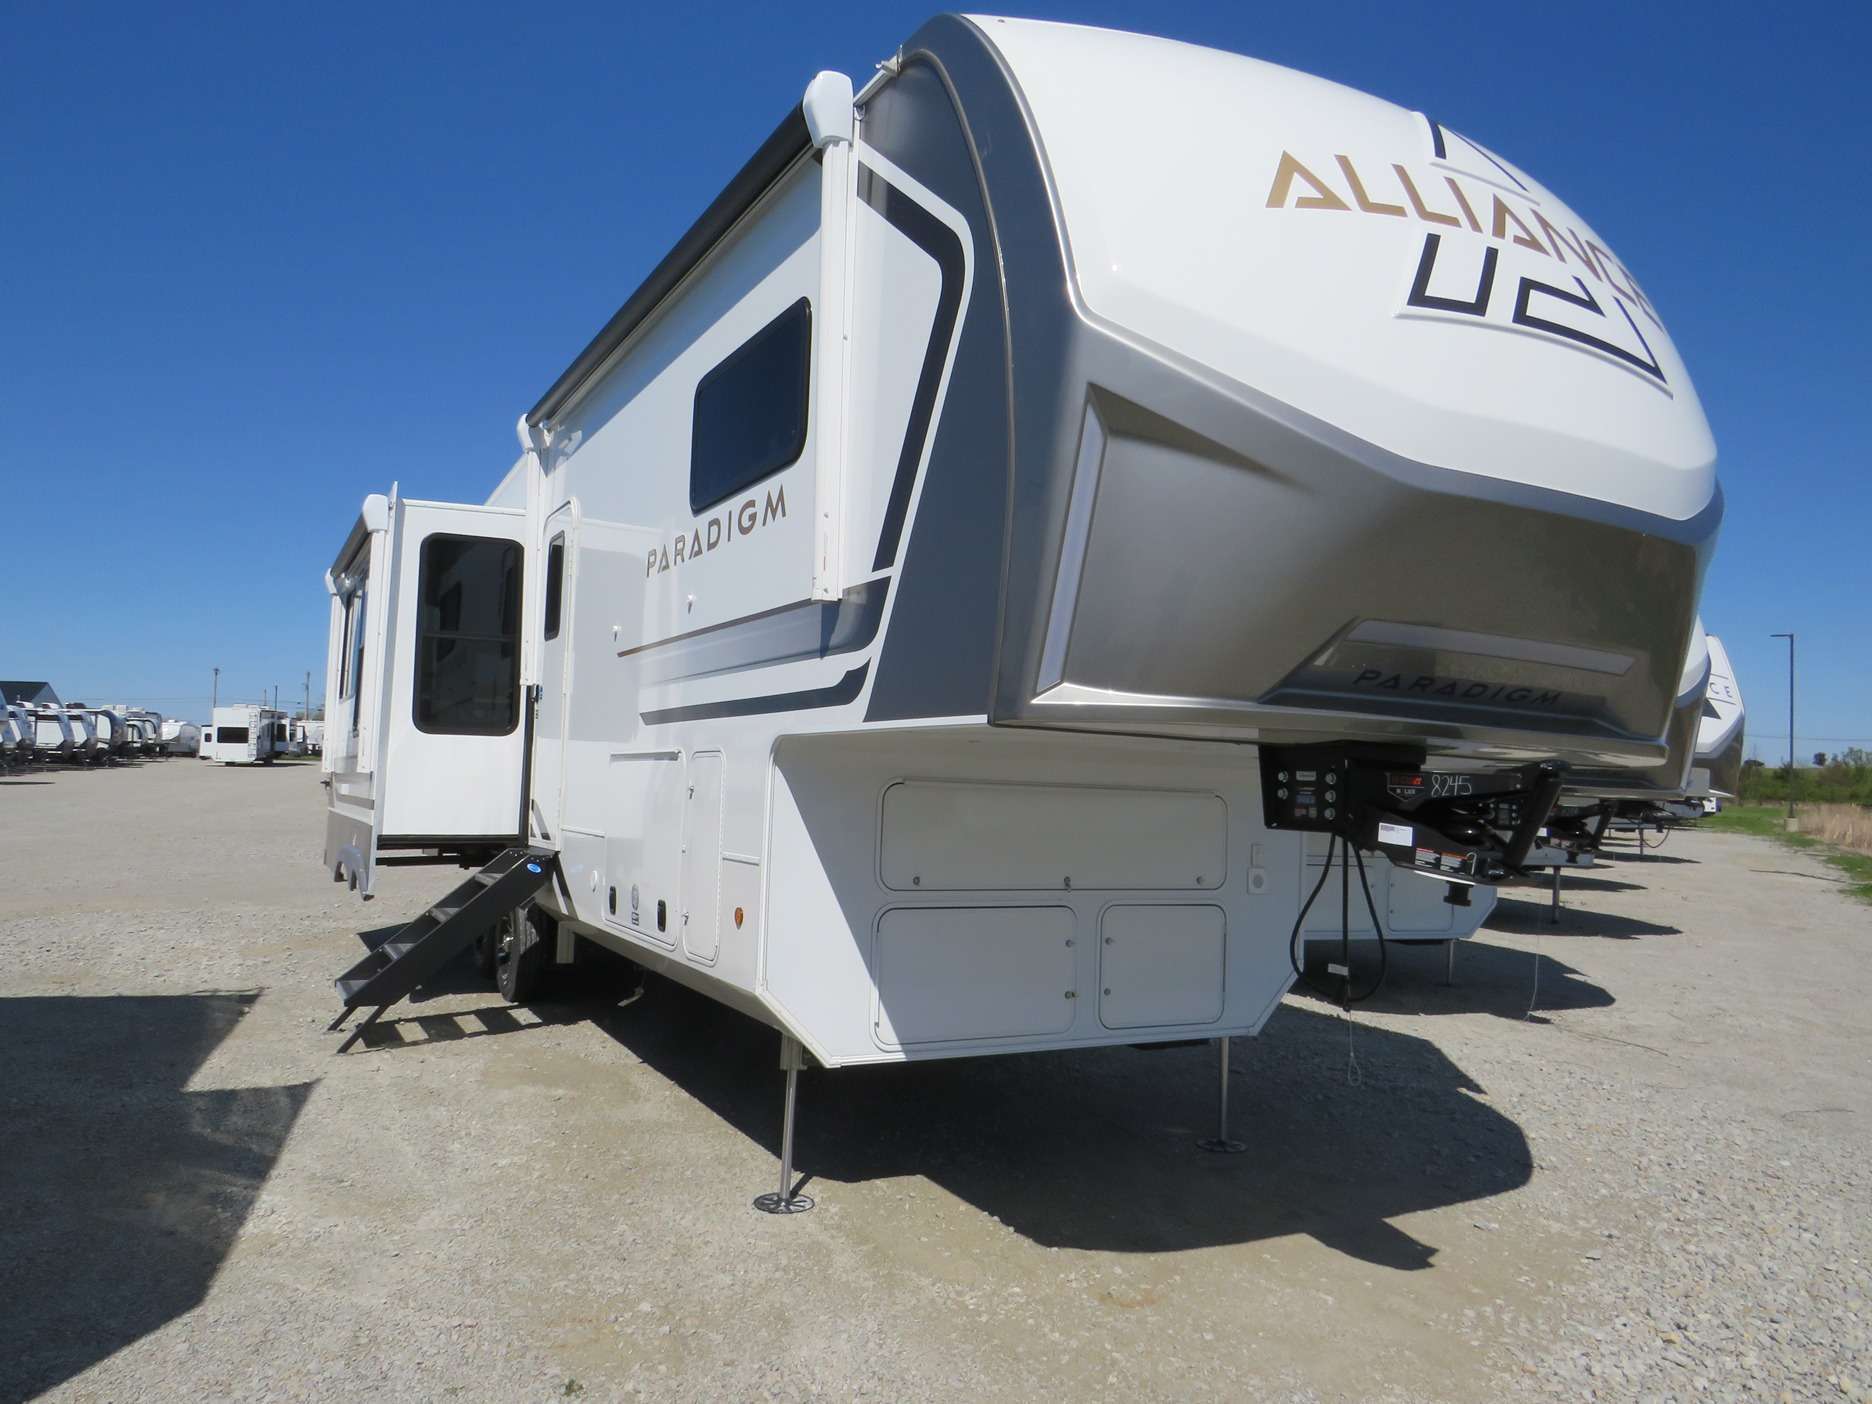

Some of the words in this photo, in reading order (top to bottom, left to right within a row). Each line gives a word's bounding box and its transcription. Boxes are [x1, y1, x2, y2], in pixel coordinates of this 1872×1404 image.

[646, 484, 787, 578] PARADIGM
[1351, 669, 1562, 706] PARADIGM
[1431, 774, 1472, 798] 8245
